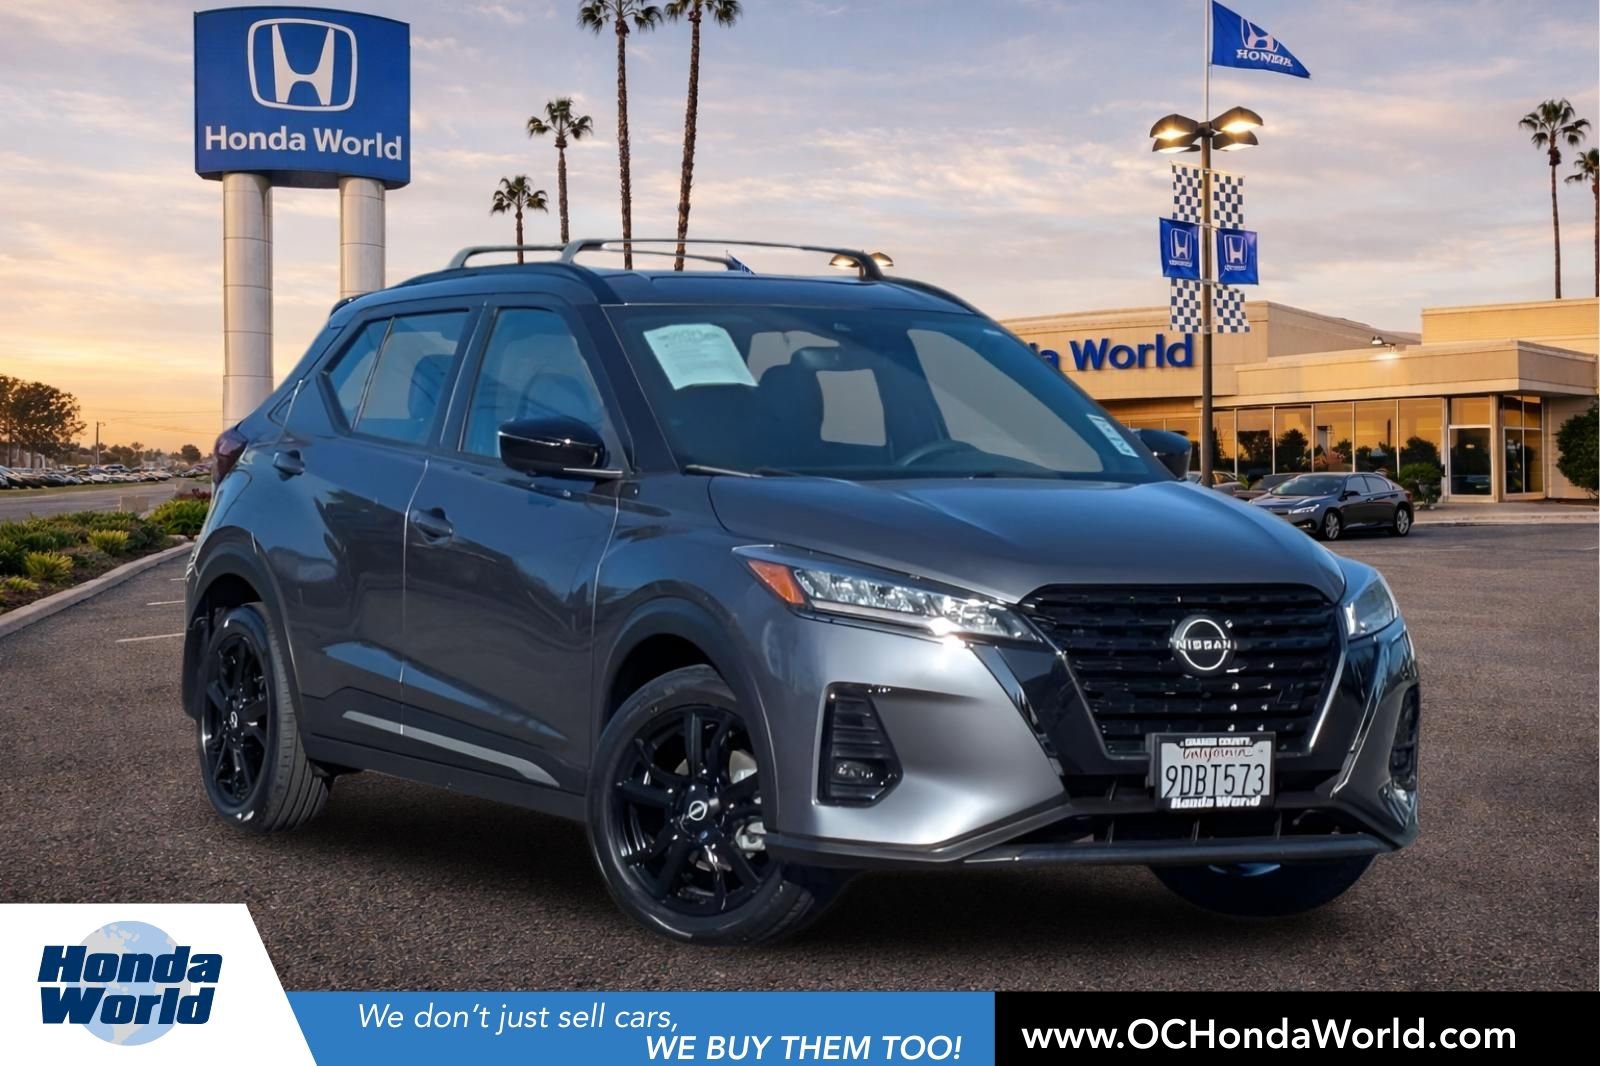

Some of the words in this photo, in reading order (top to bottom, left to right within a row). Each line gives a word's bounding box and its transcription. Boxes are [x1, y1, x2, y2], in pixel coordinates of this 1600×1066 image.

[205, 125, 306, 151] Honda
[313, 127, 402, 160] World
[1069, 333, 1194, 371] World
[1164, 763, 1265, 798] 9DBT573
